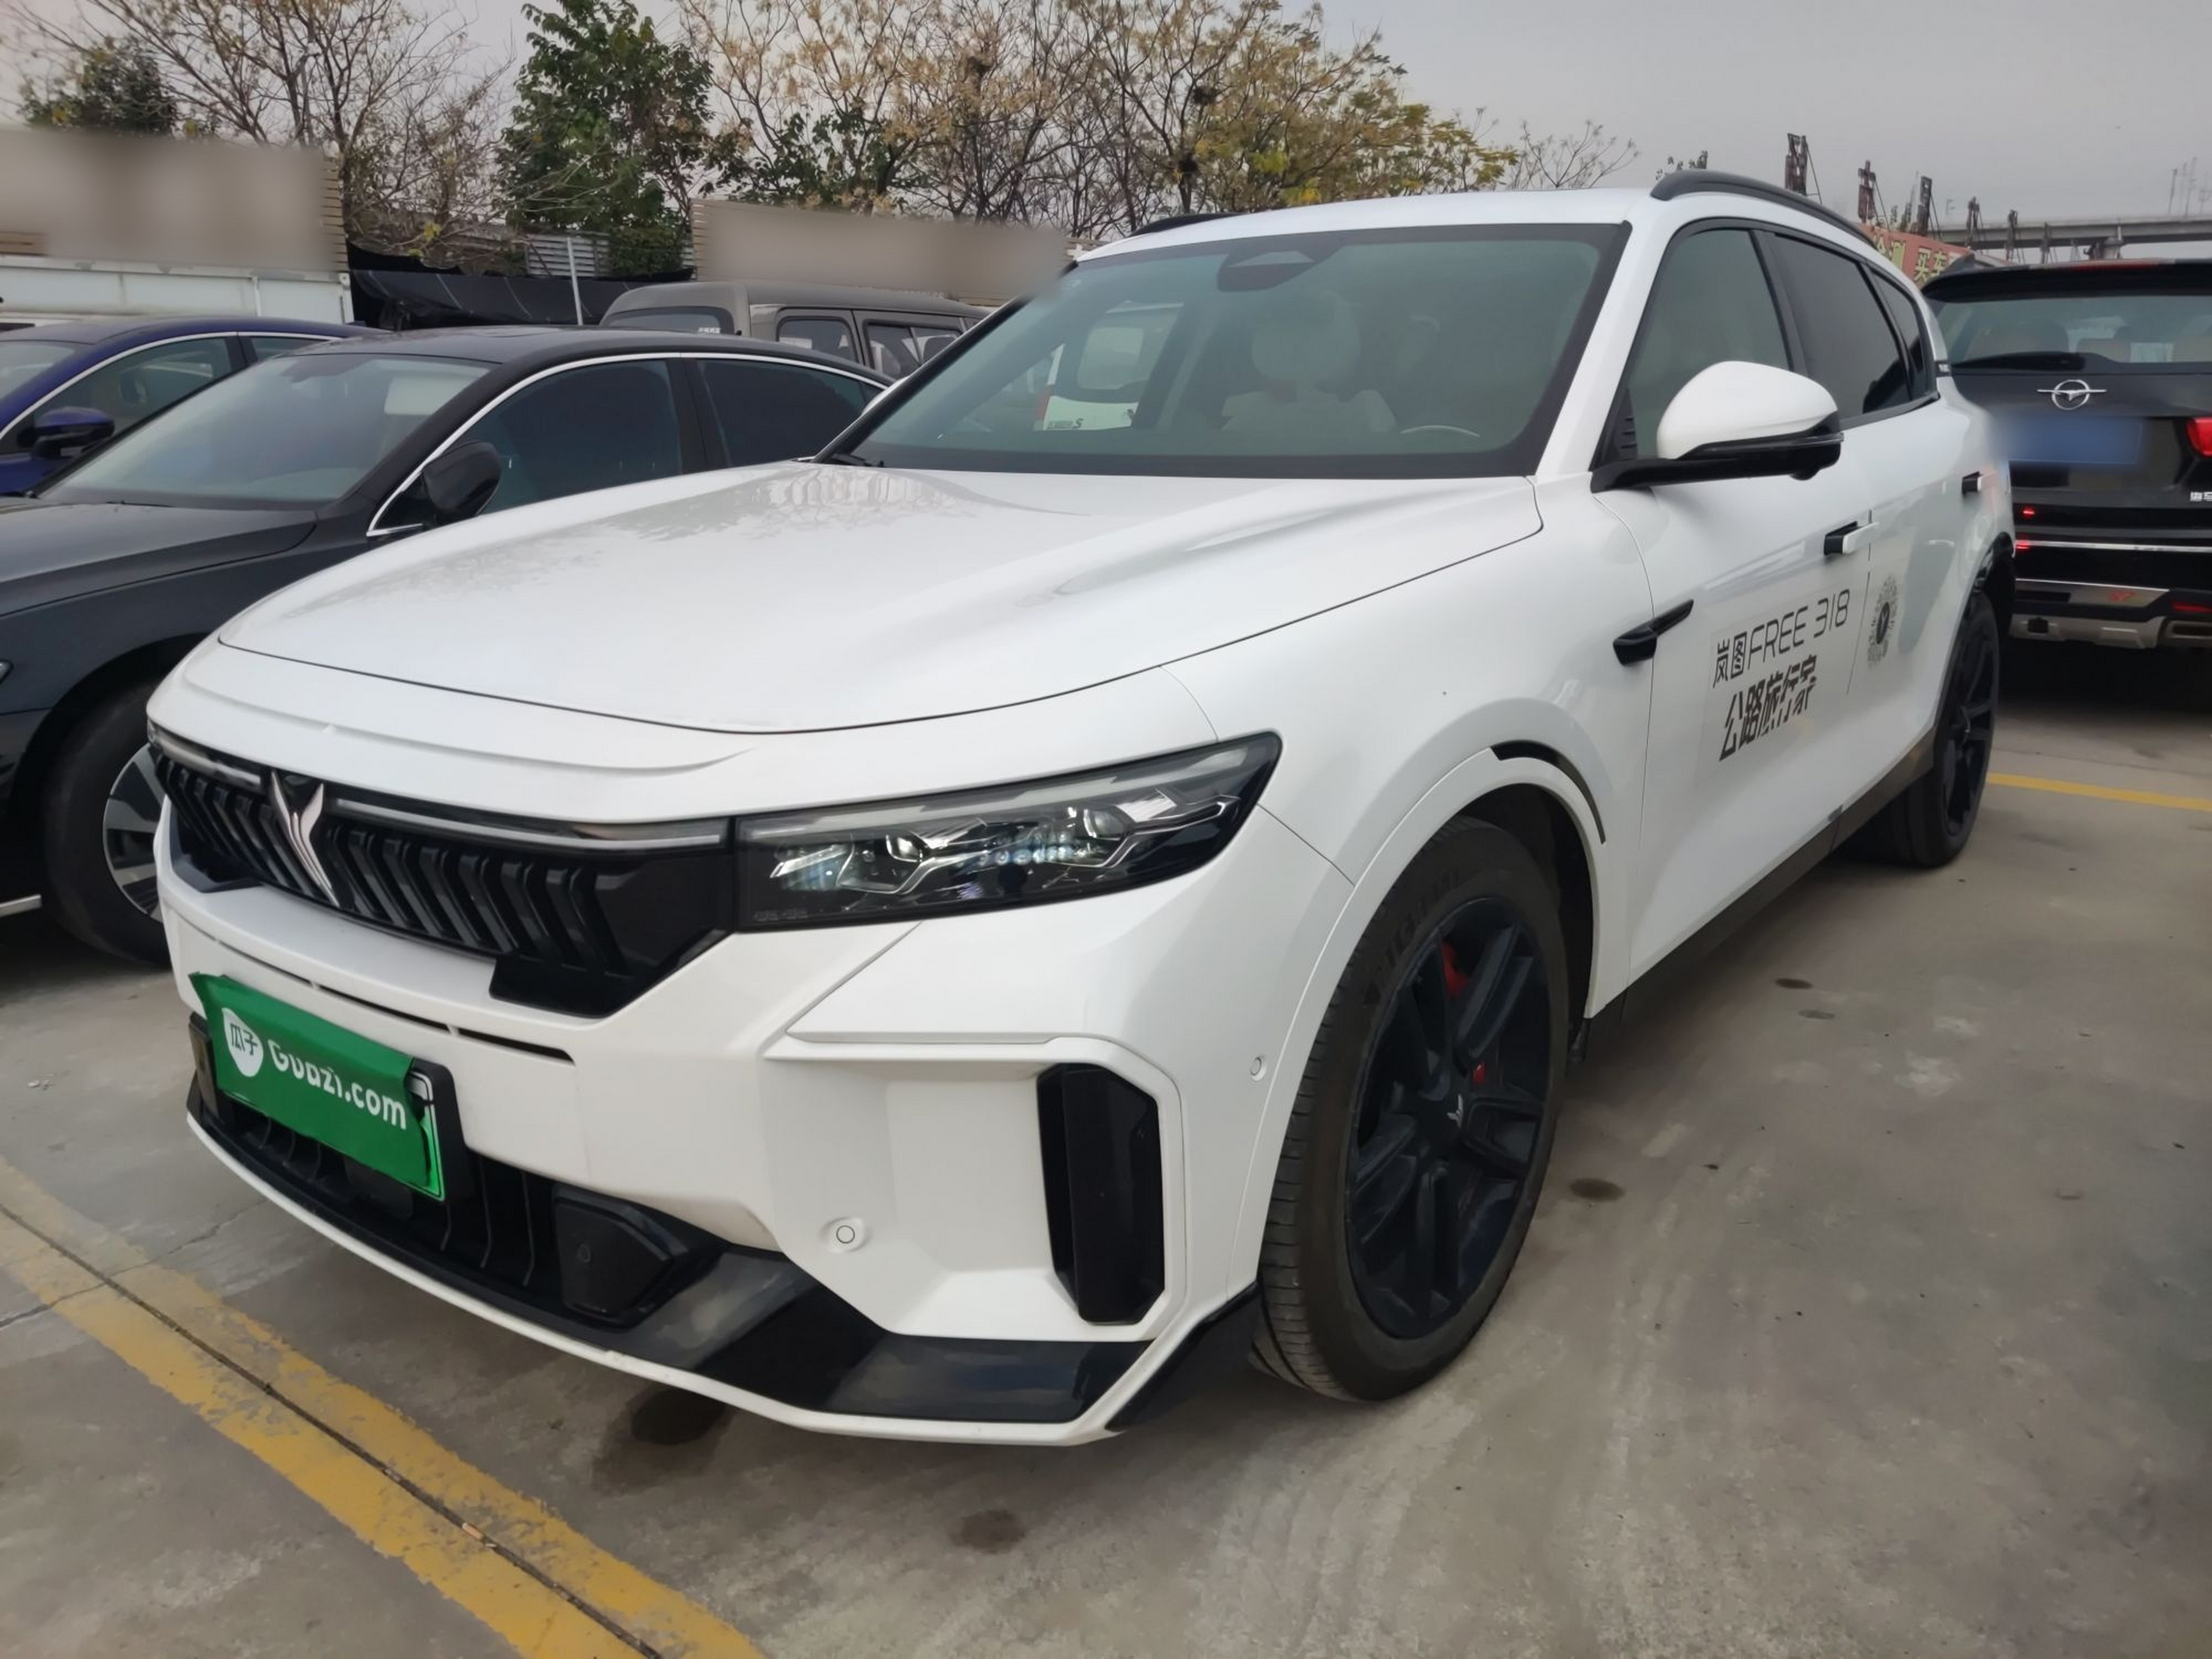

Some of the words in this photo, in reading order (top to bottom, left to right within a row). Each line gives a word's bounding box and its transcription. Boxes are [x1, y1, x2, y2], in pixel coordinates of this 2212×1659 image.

[1814, 589, 1850, 638] 318
[1719, 654, 1817, 762] 公路旅行家
[230, 1023, 258, 1056] 瓜子
[268, 1039, 406, 1130] Guazi.com
